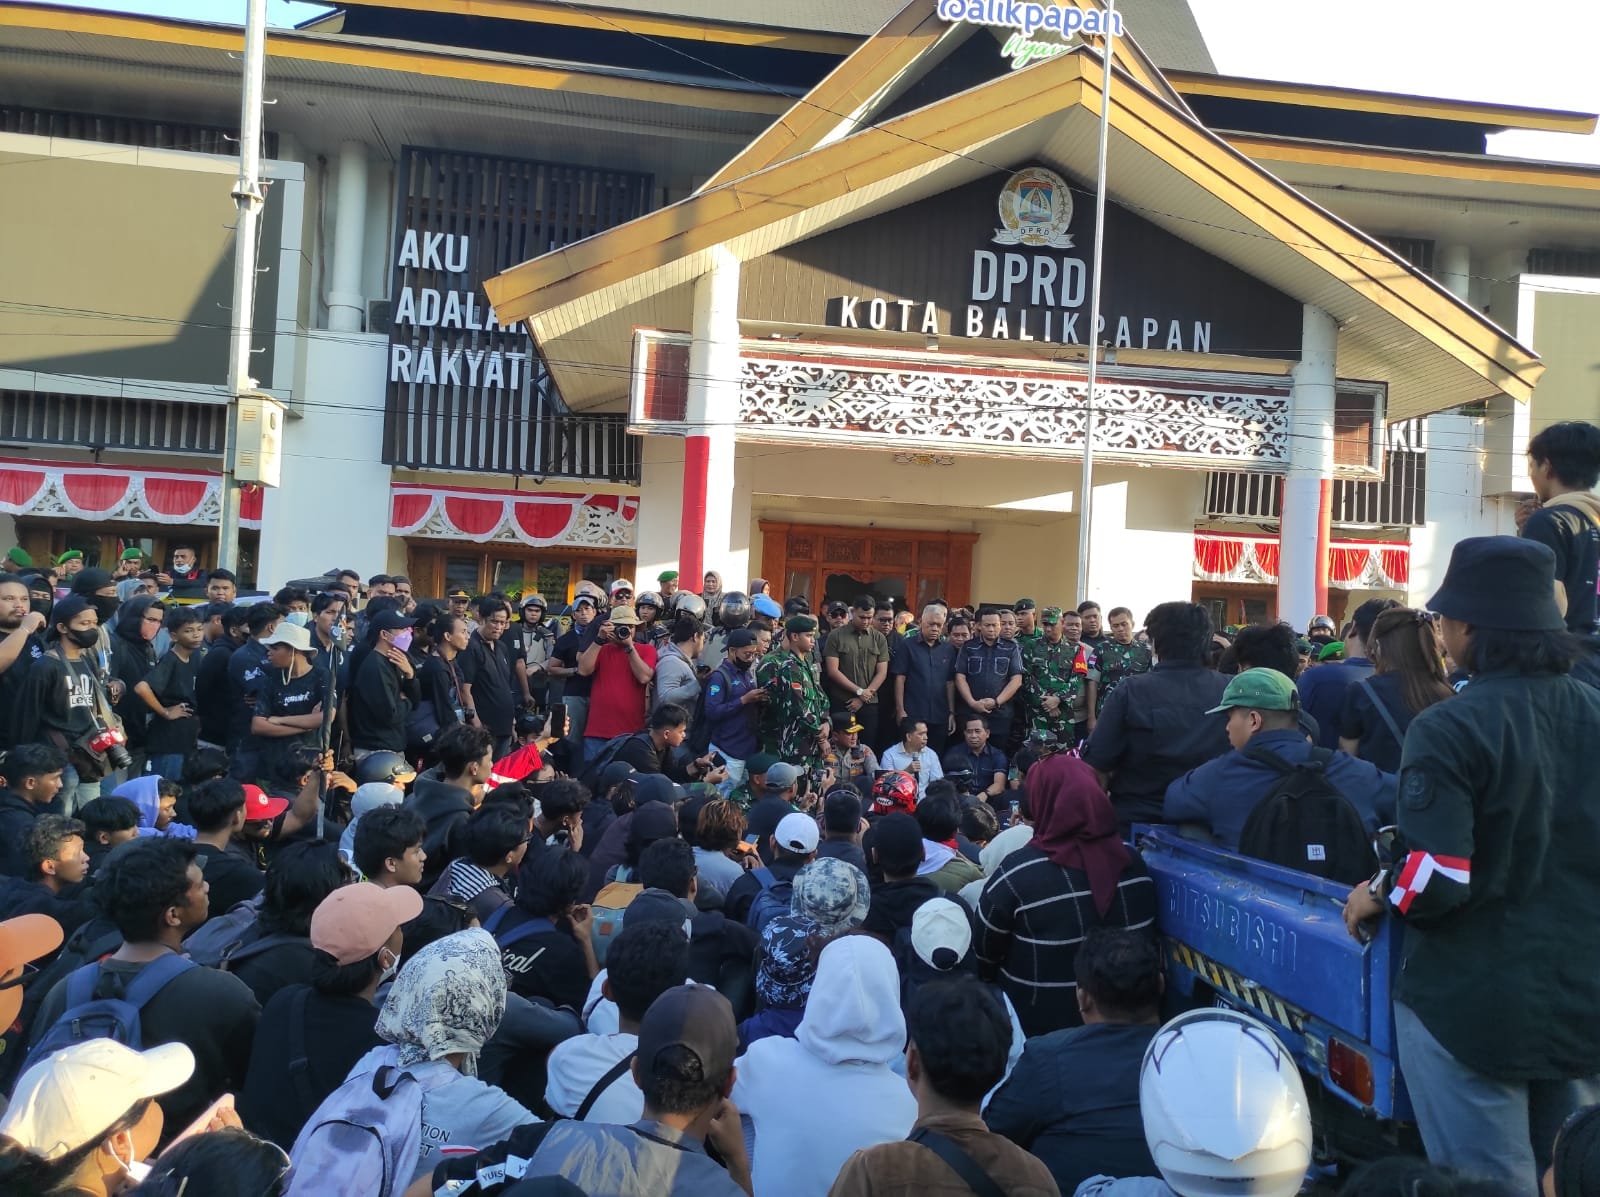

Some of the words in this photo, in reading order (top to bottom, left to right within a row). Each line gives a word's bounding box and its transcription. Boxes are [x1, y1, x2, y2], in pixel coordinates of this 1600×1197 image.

[398, 229, 469, 273] AKU
[1020, 227, 1050, 236] DPRD
[972, 249, 1087, 308] DPRD
[840, 295, 939, 334] KOTA
[966, 304, 1212, 353] BALIKPAPAN
[390, 344, 526, 390] RAKYAT
